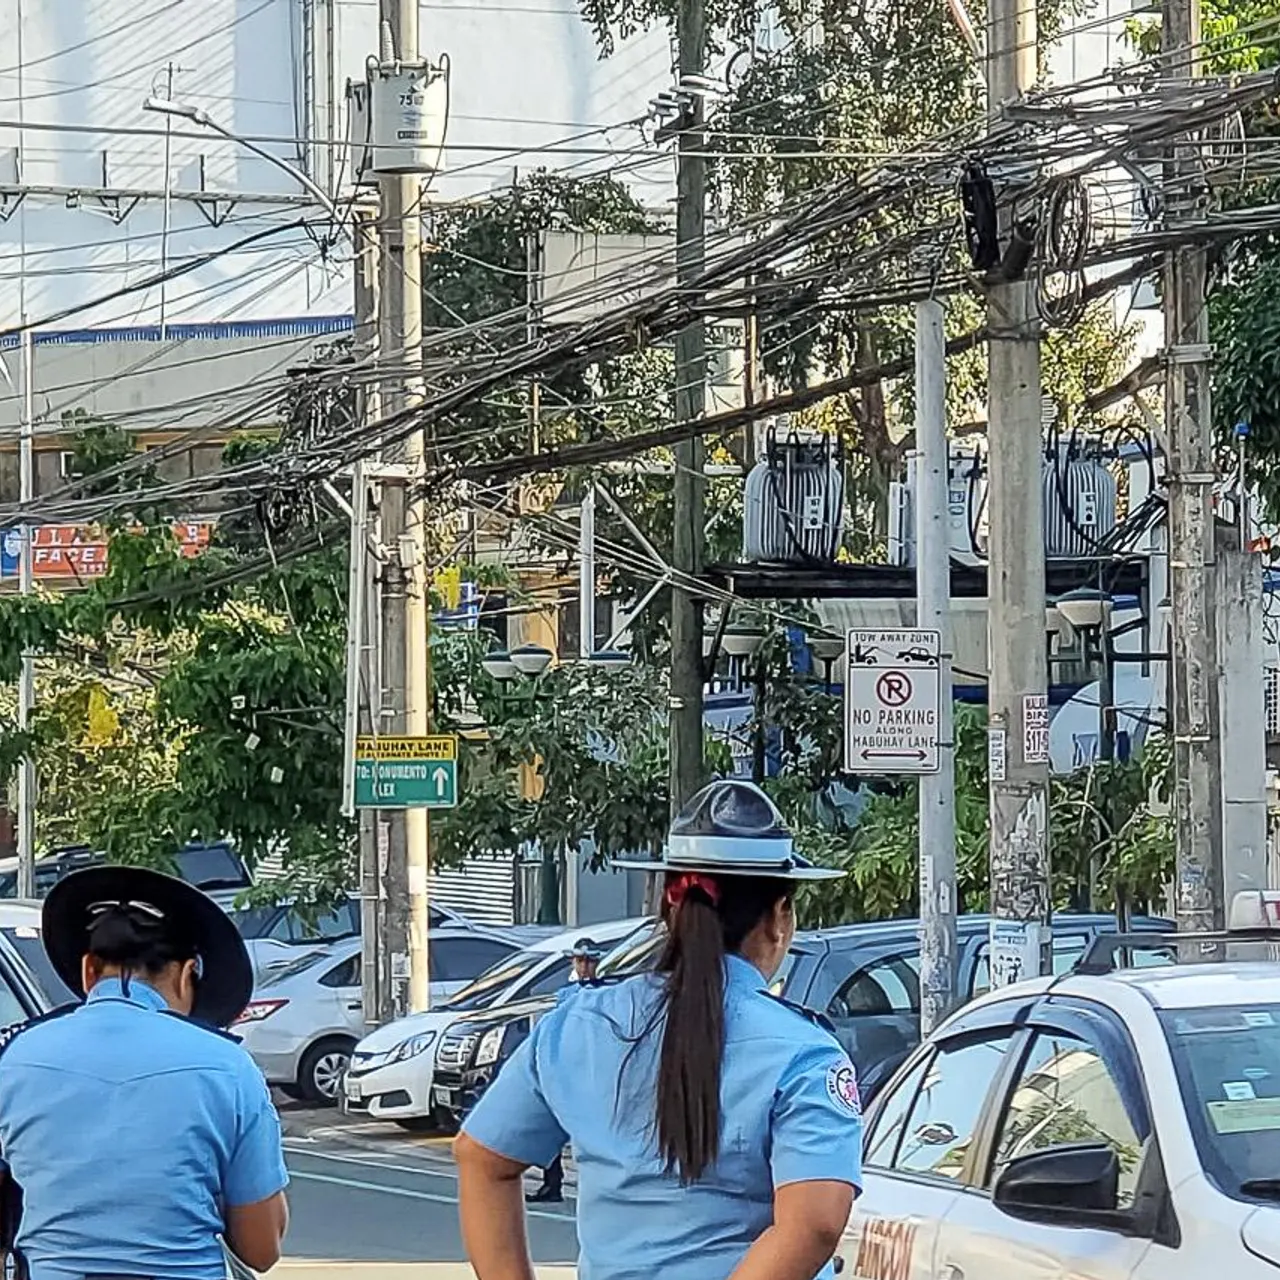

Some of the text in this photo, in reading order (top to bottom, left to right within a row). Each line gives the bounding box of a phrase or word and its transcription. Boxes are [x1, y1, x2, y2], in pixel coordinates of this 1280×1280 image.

[854, 632, 935, 643] TOW AWAY ZONE
[853, 709, 935, 725] NO PARKING
[876, 726, 913, 735] ALONG
[418, 742, 449, 751] LANE
[853, 736, 935, 748] MABUHAY LANE
